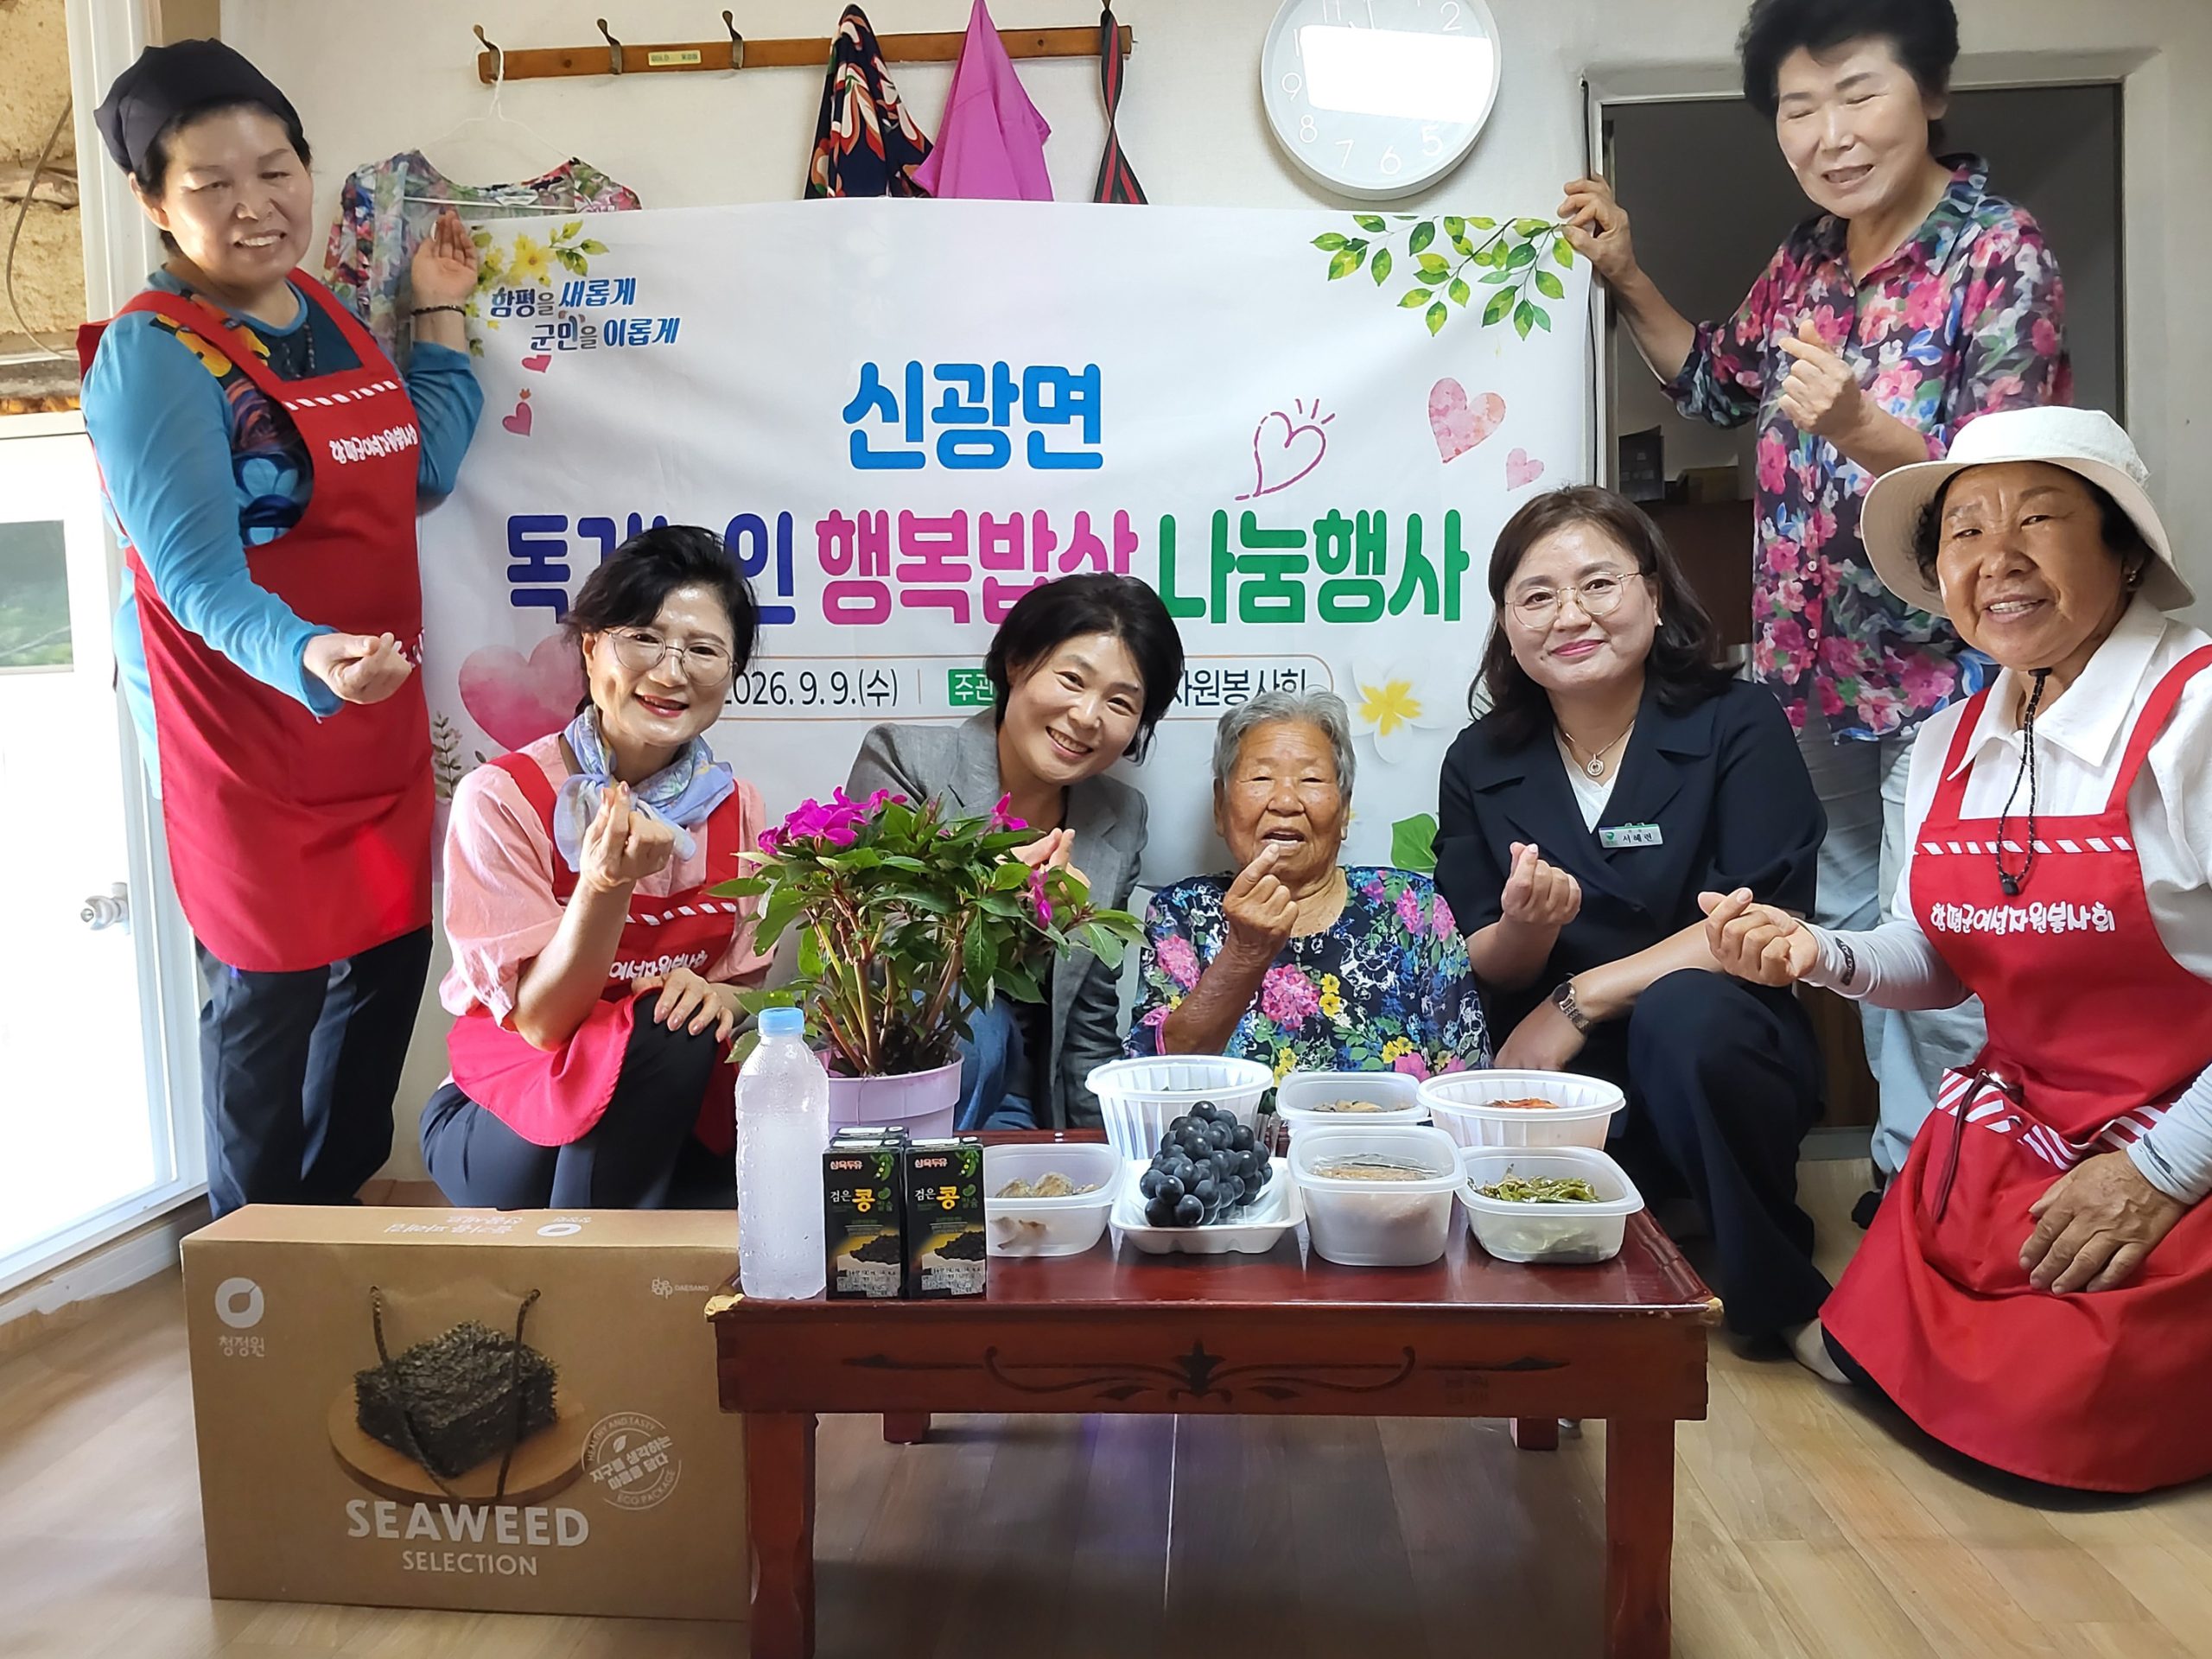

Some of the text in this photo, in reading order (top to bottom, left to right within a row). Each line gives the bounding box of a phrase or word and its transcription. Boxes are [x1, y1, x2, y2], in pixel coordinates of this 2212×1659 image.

[1440, 1, 1462, 32] 2
[1281, 72, 1302, 101] 9
[1300, 114, 1318, 143] 8
[1421, 124, 1443, 156] 5
[1335, 138, 1355, 168] 7
[1380, 145, 1402, 175] 6
[490, 277, 637, 318] 함평을 새롭게
[531, 315, 681, 351] 군민을 이롭게
[842, 360, 1103, 470] 신광면
[506, 511, 796, 625] 독인
[1159, 508, 1470, 624] 나눔행사
[724, 668, 897, 707] 026.9.9.(수)
[1930, 900, 2116, 935] 함평군여성자원봉사회
[219, 1335, 264, 1357] 청정원
[588, 1417, 656, 1461] HEALTHY AND TASTY
[626, 1435, 673, 1465] 생각하는
[617, 1469, 676, 1504] ECO PACKAGE
[346, 1498, 589, 1547] SEAWEED
[402, 1550, 537, 1576] SELECTION
